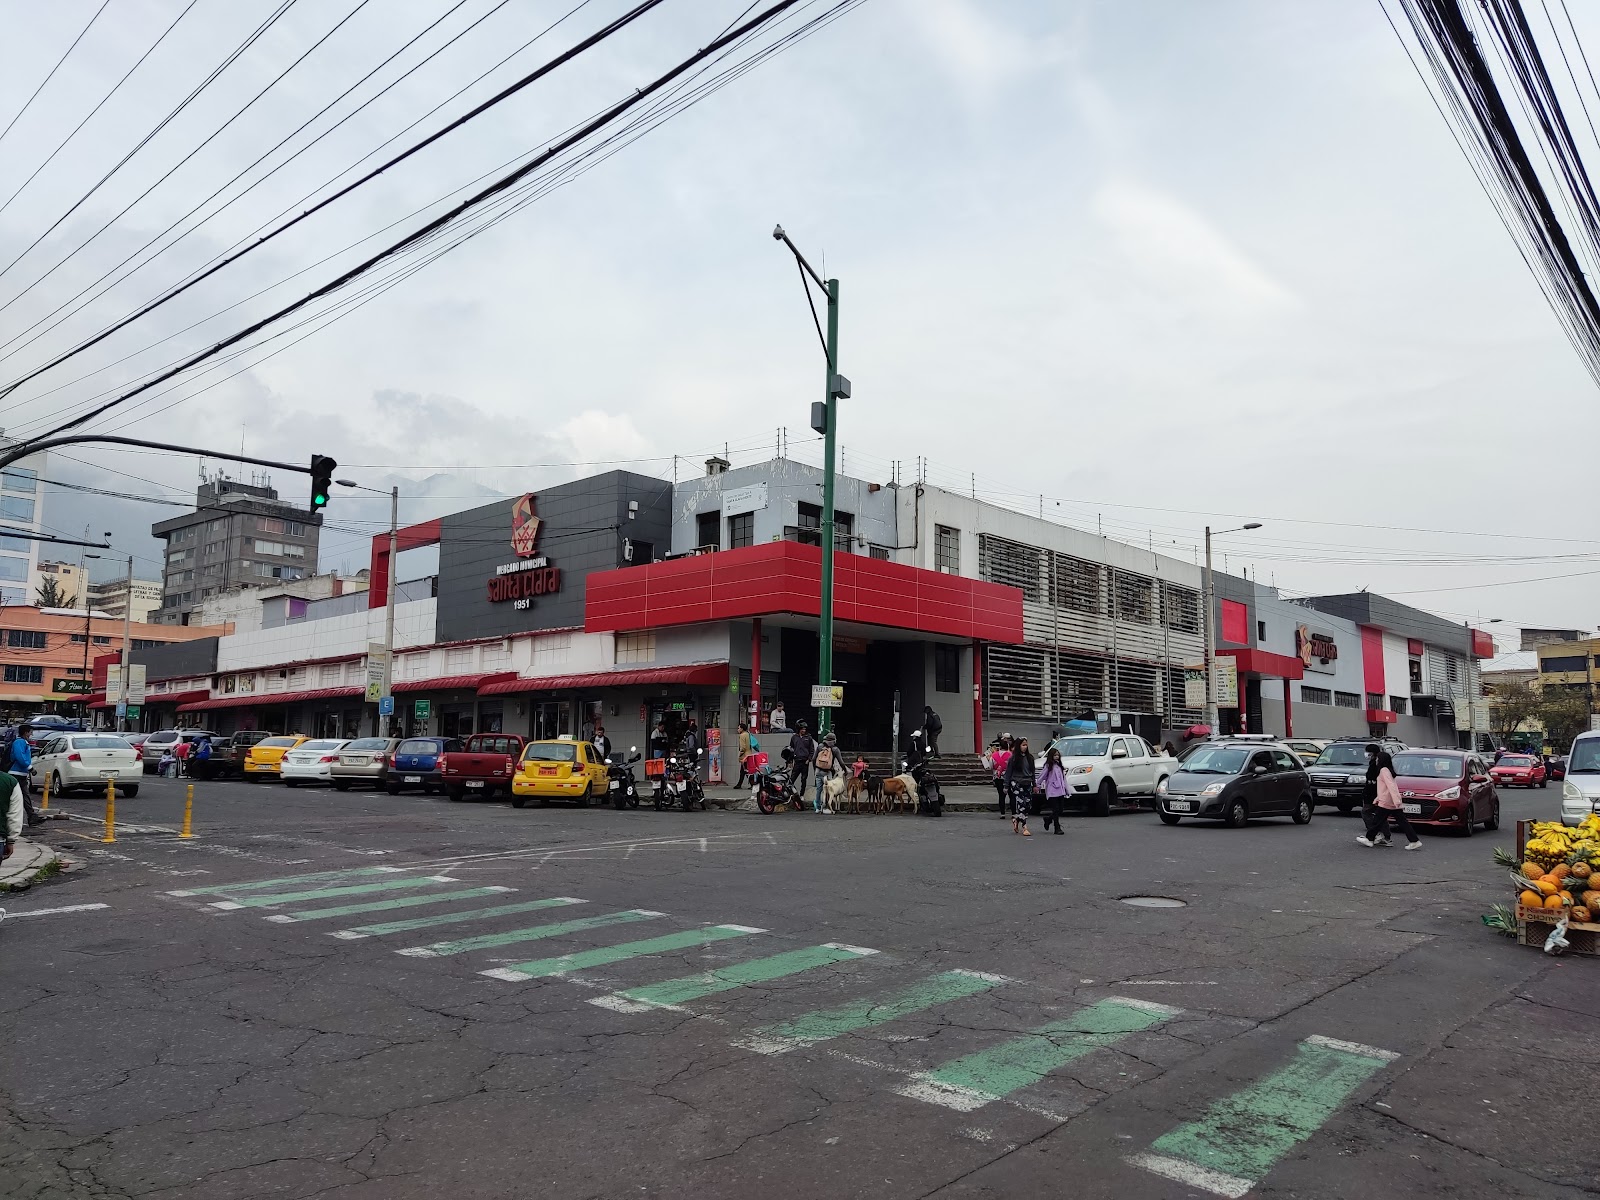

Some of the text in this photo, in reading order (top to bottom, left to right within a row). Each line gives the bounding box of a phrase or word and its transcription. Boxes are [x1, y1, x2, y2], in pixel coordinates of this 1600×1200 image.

[496, 557, 547, 575] MERCADO MUNICIPAL
[514, 599, 530, 610] 1951
